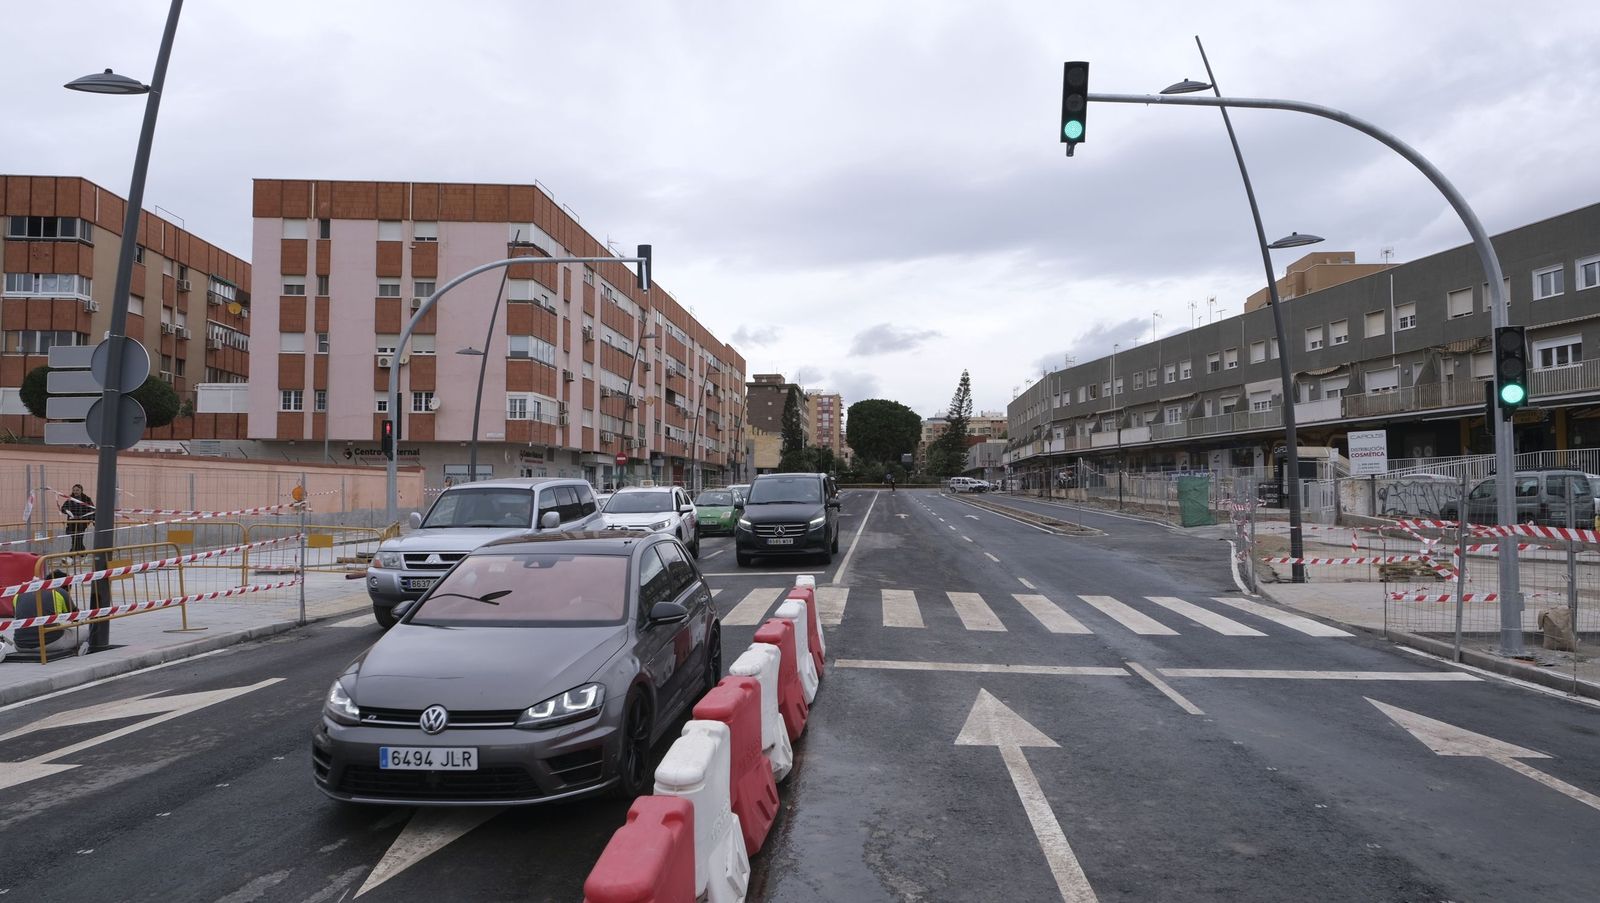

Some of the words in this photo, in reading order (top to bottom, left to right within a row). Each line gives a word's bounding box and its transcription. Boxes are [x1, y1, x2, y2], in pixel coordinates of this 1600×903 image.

[354, 448, 382, 456] Centro
[411, 580, 431, 588] 8637
[391, 750, 434, 767] 6494
[440, 751, 472, 768] JLR
